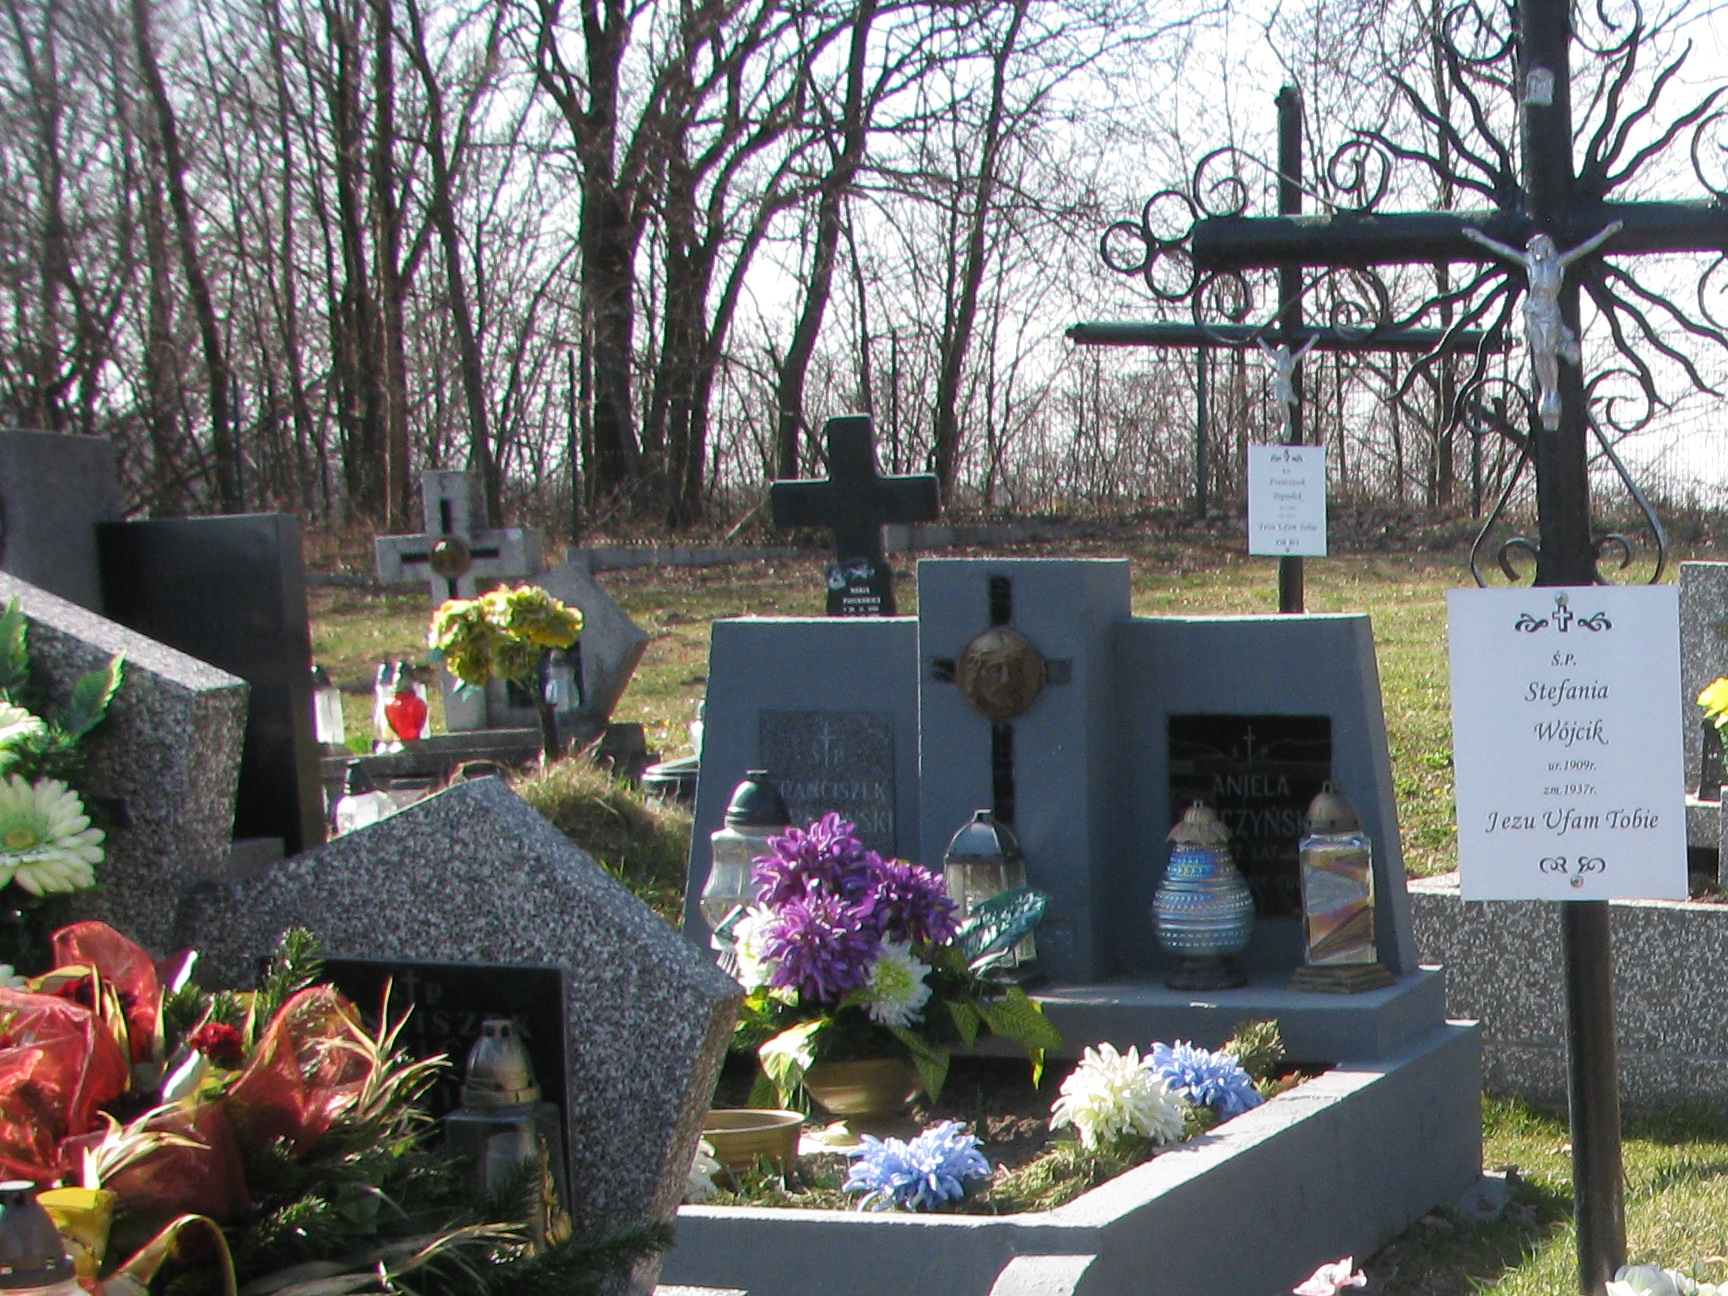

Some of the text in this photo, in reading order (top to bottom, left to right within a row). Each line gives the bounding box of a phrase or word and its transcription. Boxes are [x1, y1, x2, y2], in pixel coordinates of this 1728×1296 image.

[1551, 649, 1577, 666] Ś.P.
[1524, 678, 1609, 707] Stefania
[1534, 719, 1609, 748] Wójcik
[1212, 775, 1290, 797] ANIELA
[1484, 808, 1659, 837] Jezu Ufam Tobie
